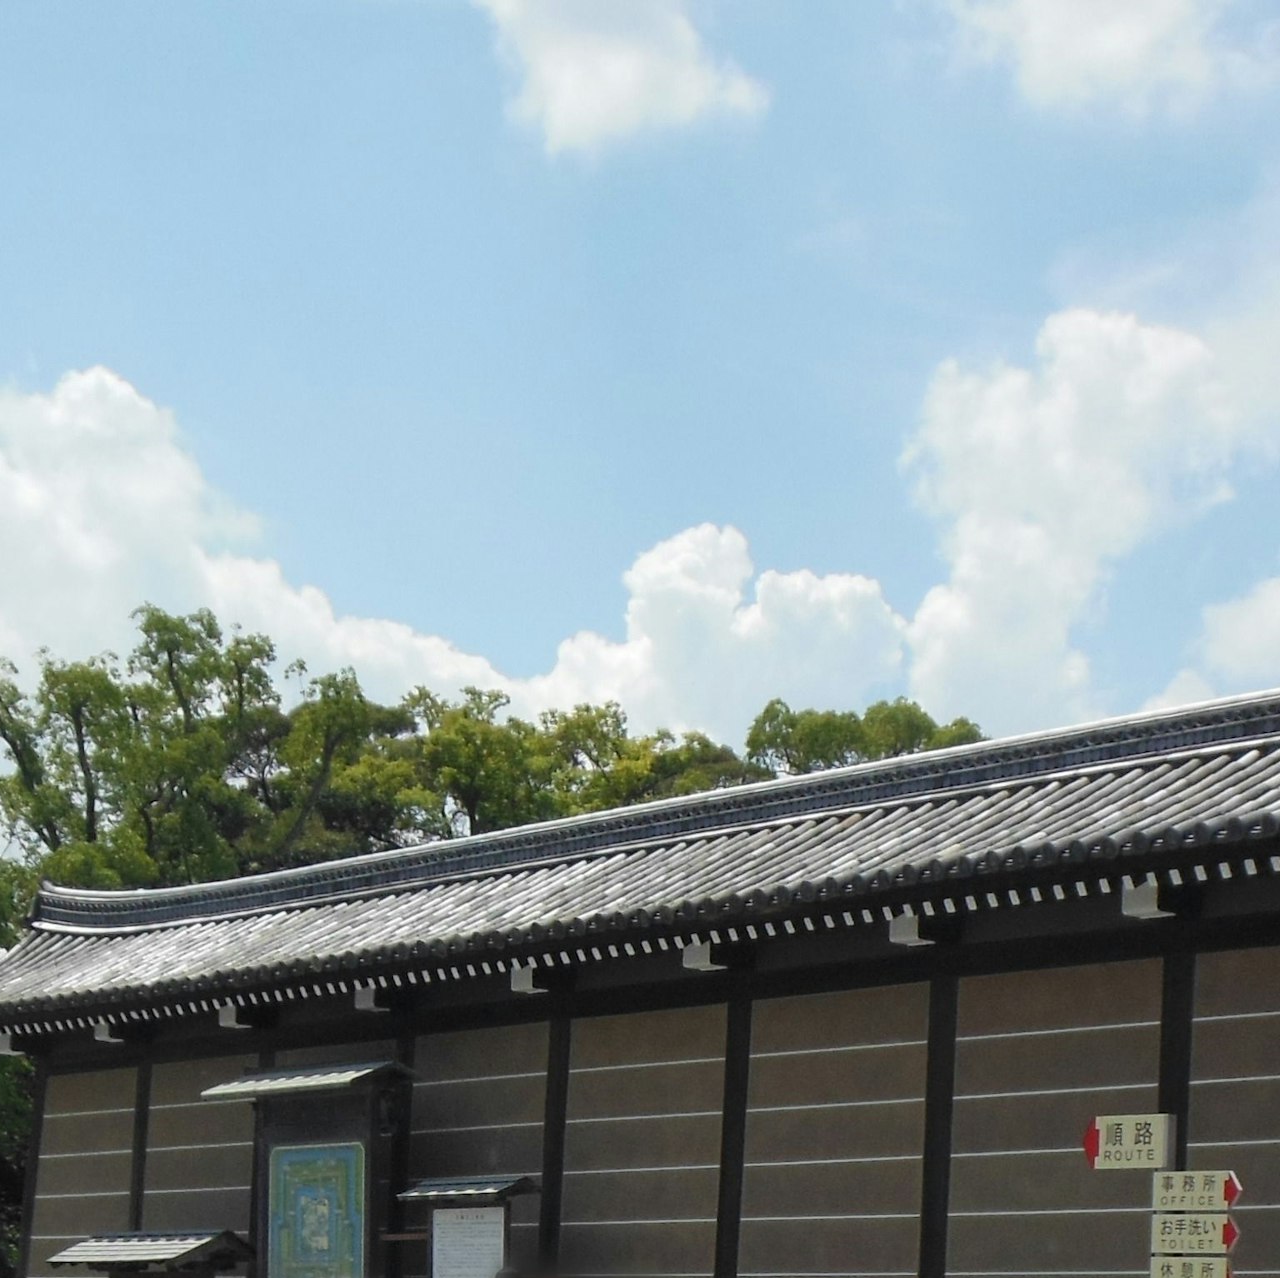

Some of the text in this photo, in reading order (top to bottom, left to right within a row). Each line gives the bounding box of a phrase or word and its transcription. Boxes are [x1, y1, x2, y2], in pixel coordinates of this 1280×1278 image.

[1106, 1121, 1153, 1146] 順路
[1104, 1149, 1155, 1161] ROUTE
[1161, 1174, 1216, 1192] 事務所
[1161, 1195, 1215, 1206] OFFICE
[1161, 1219, 1217, 1236] お手洗い
[1161, 1239, 1214, 1250] TOILET
[1161, 1262, 1215, 1278] 休憩所
